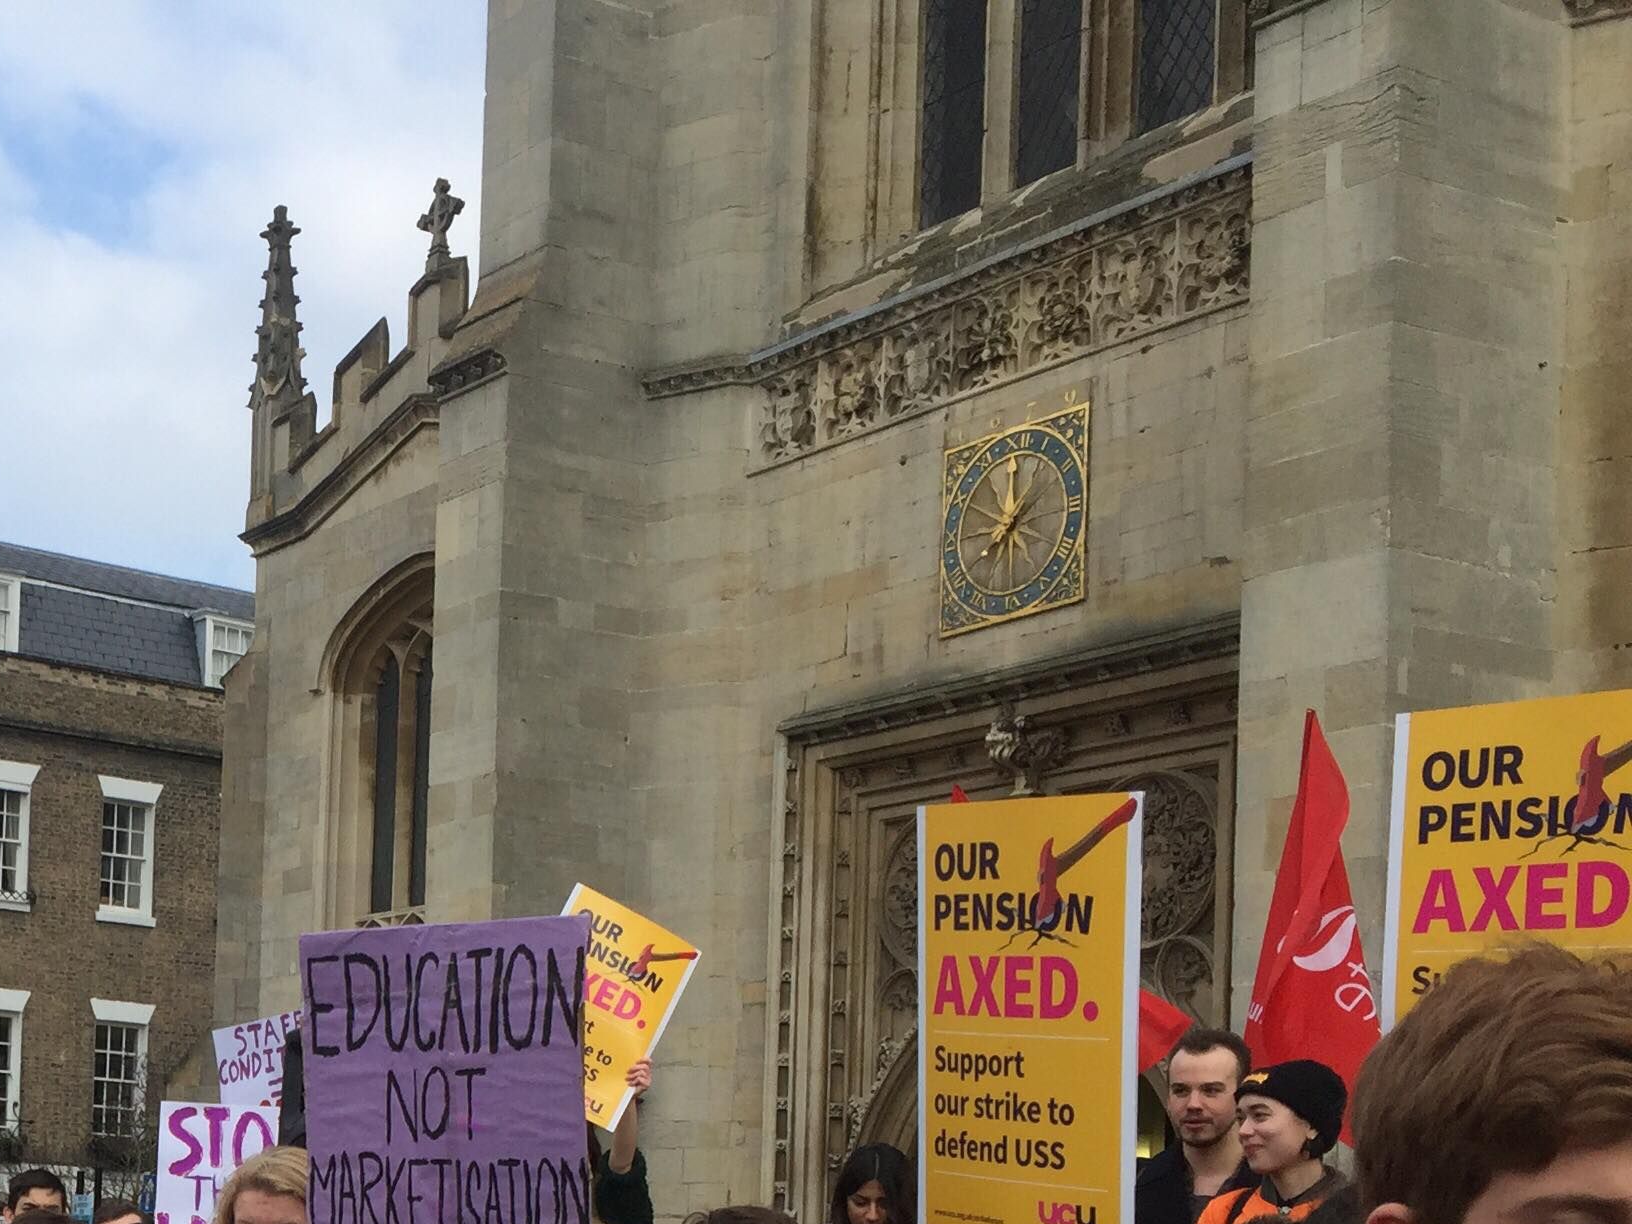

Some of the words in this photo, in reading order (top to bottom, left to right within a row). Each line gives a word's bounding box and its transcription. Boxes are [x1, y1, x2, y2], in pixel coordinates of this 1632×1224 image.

[1421, 745, 1524, 791] OUR
[935, 842, 1000, 881] OUR
[934, 892, 1094, 935] PENSION
[1412, 861, 1631, 934] AXED
[587, 938, 665, 993] NSION
[933, 955, 1099, 1021] AXED.
[306, 944, 586, 1056] EDUCATION
[584, 968, 646, 1030] XED.
[935, 1045, 1025, 1082] Support
[386, 1066, 487, 1145] NOT
[935, 1092, 969, 1116] our
[974, 1091, 1042, 1124] strike
[1048, 1098, 1075, 1126] to
[935, 1129, 1008, 1164] defend
[1015, 1138, 1066, 1170] USS
